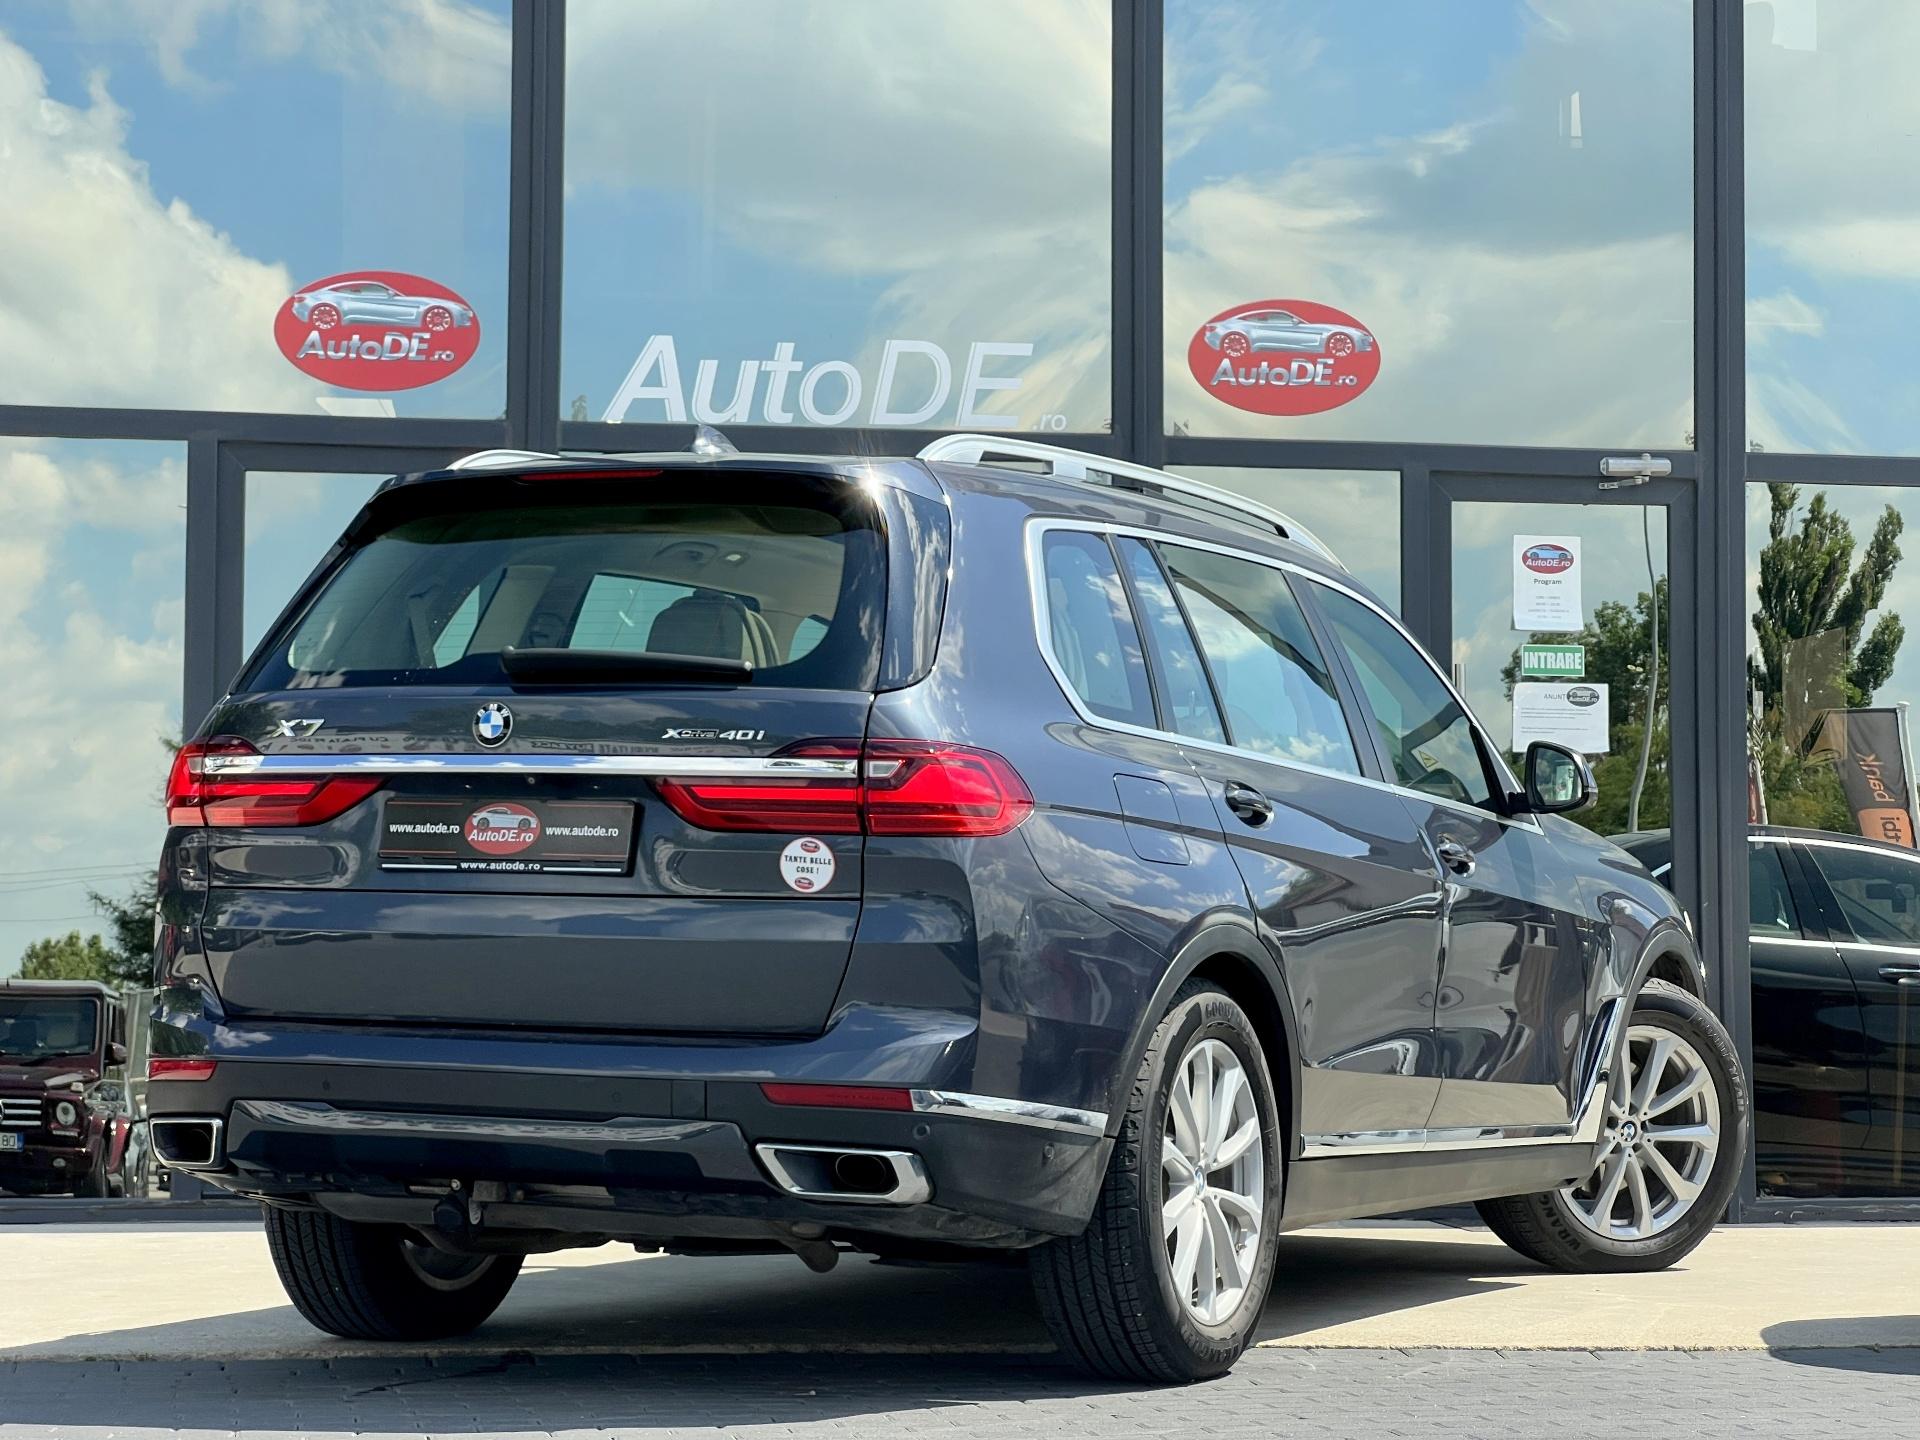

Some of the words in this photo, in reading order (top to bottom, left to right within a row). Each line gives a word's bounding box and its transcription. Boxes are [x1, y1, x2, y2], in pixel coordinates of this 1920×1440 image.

[296, 330, 455, 362] AutoDE.ro
[1210, 358, 1358, 387] AutoDE.ro
[1525, 558, 1571, 567] AutoDE.ro
[1533, 578, 1562, 586] Program
[1524, 651, 1582, 670] INTRARE
[271, 718, 325, 738] X7
[389, 823, 461, 834] www.autode.ro
[545, 826, 619, 837] www.autode.ro
[468, 829, 534, 843] AutoDE.ro
[784, 854, 808, 864] TANTE
[810, 856, 833, 866] BELLE
[460, 861, 541, 871] www.autode.ro
[796, 865, 814, 874] COSE
